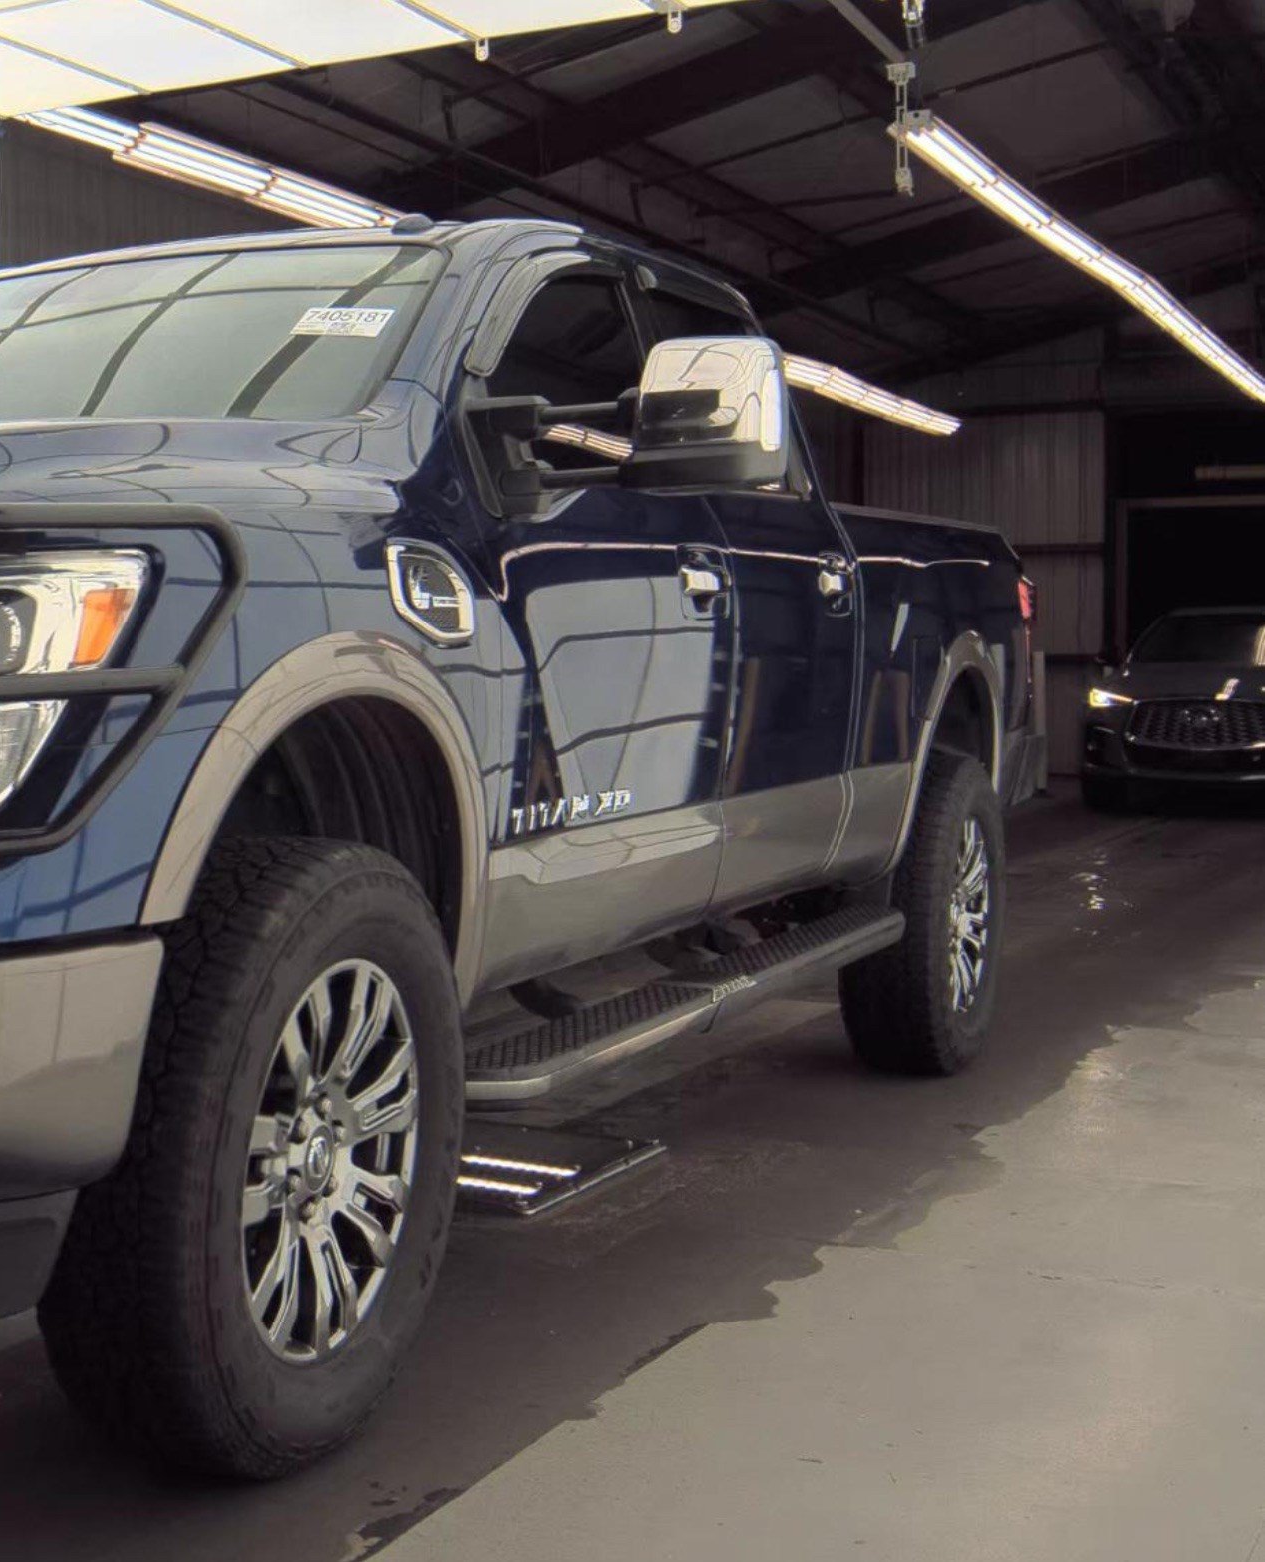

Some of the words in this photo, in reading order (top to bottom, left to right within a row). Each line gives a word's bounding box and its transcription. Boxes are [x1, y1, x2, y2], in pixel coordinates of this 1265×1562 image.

[307, 309, 390, 322] 7405181
[511, 795, 589, 834] TITAN
[595, 789, 631, 816] XD
